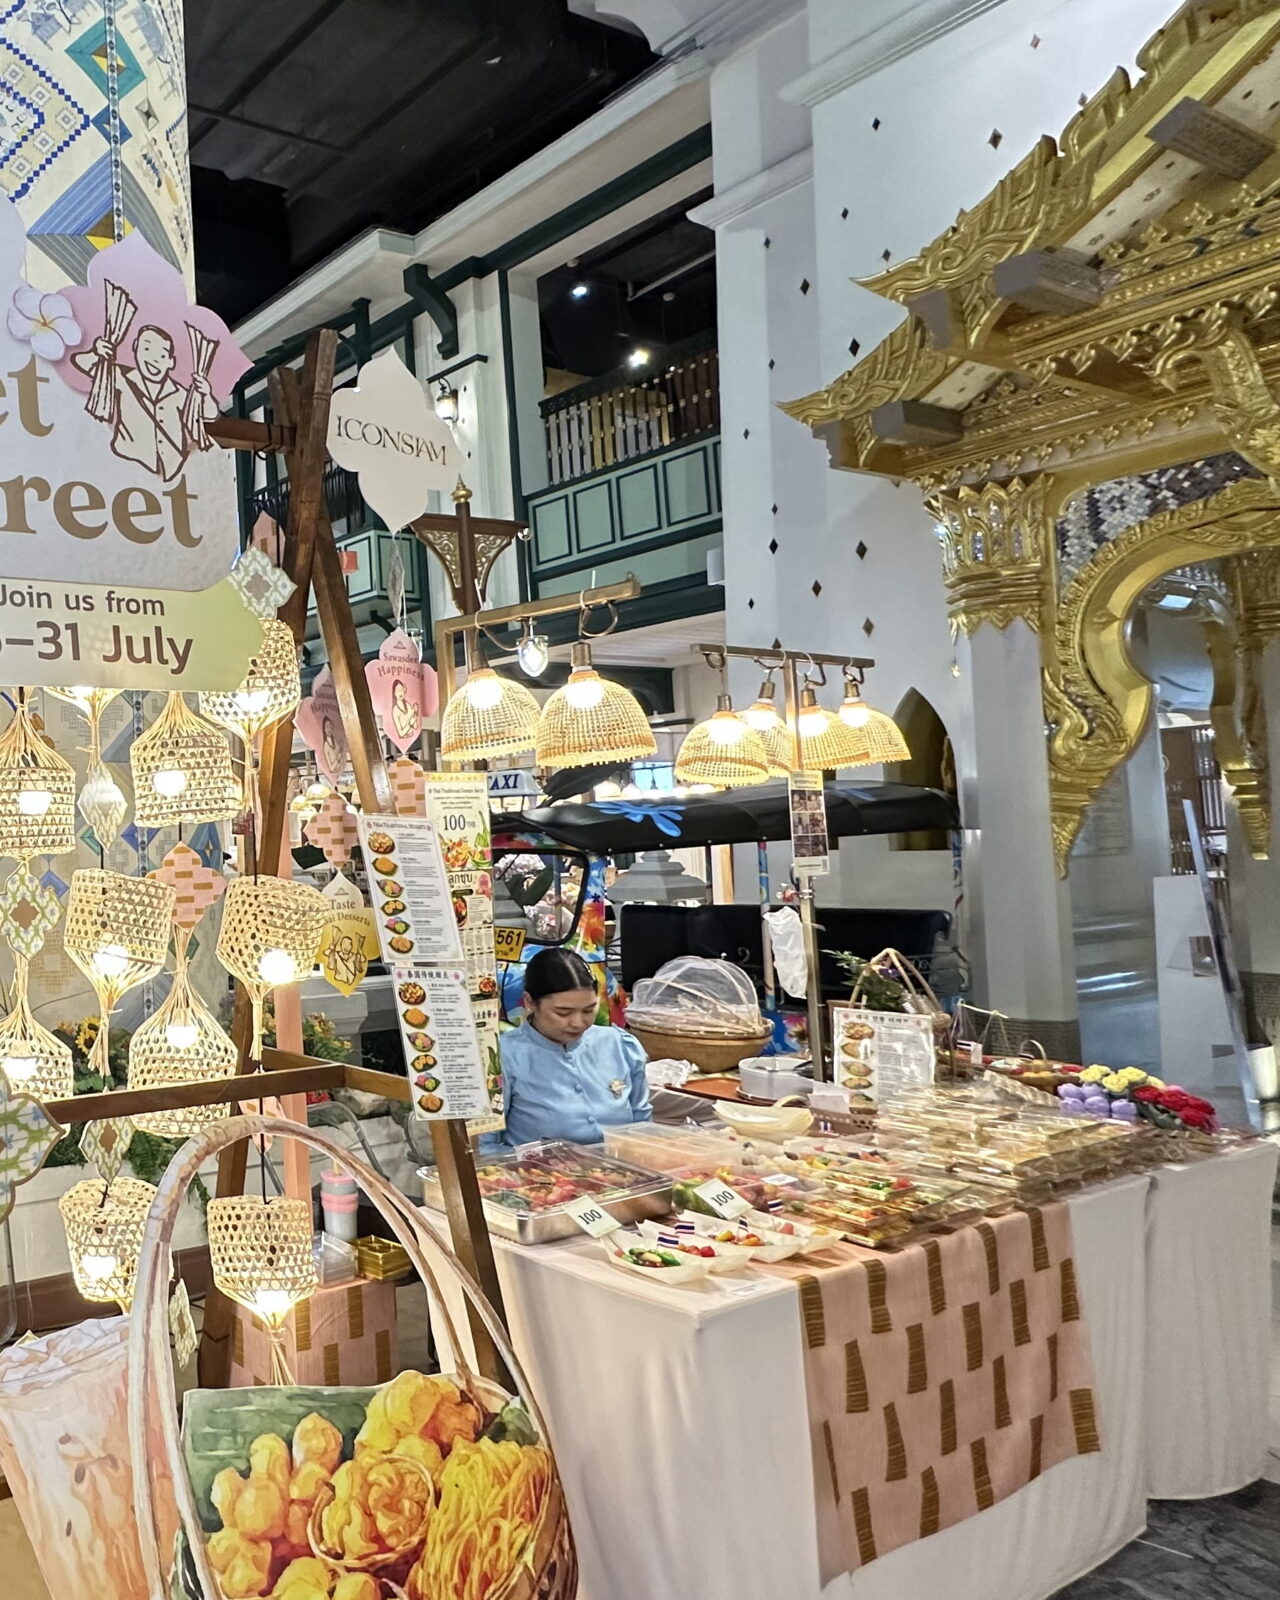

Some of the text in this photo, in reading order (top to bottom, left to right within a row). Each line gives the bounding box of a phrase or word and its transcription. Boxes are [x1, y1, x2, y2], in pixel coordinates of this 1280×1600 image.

[335, 414, 447, 467] ICONSIAM
[64, 593, 96, 612] us
[105, 590, 166, 616] from
[102, 623, 195, 676] July
[383, 652, 419, 664] Sawasdee
[488, 773, 520, 790] AXI
[443, 814, 466, 831] 100
[328, 899, 356, 910] Taste
[337, 912, 370, 926] Desserts
[494, 929, 522, 947] 561
[710, 1190, 735, 1207] 100
[577, 1208, 602, 1225] 100
